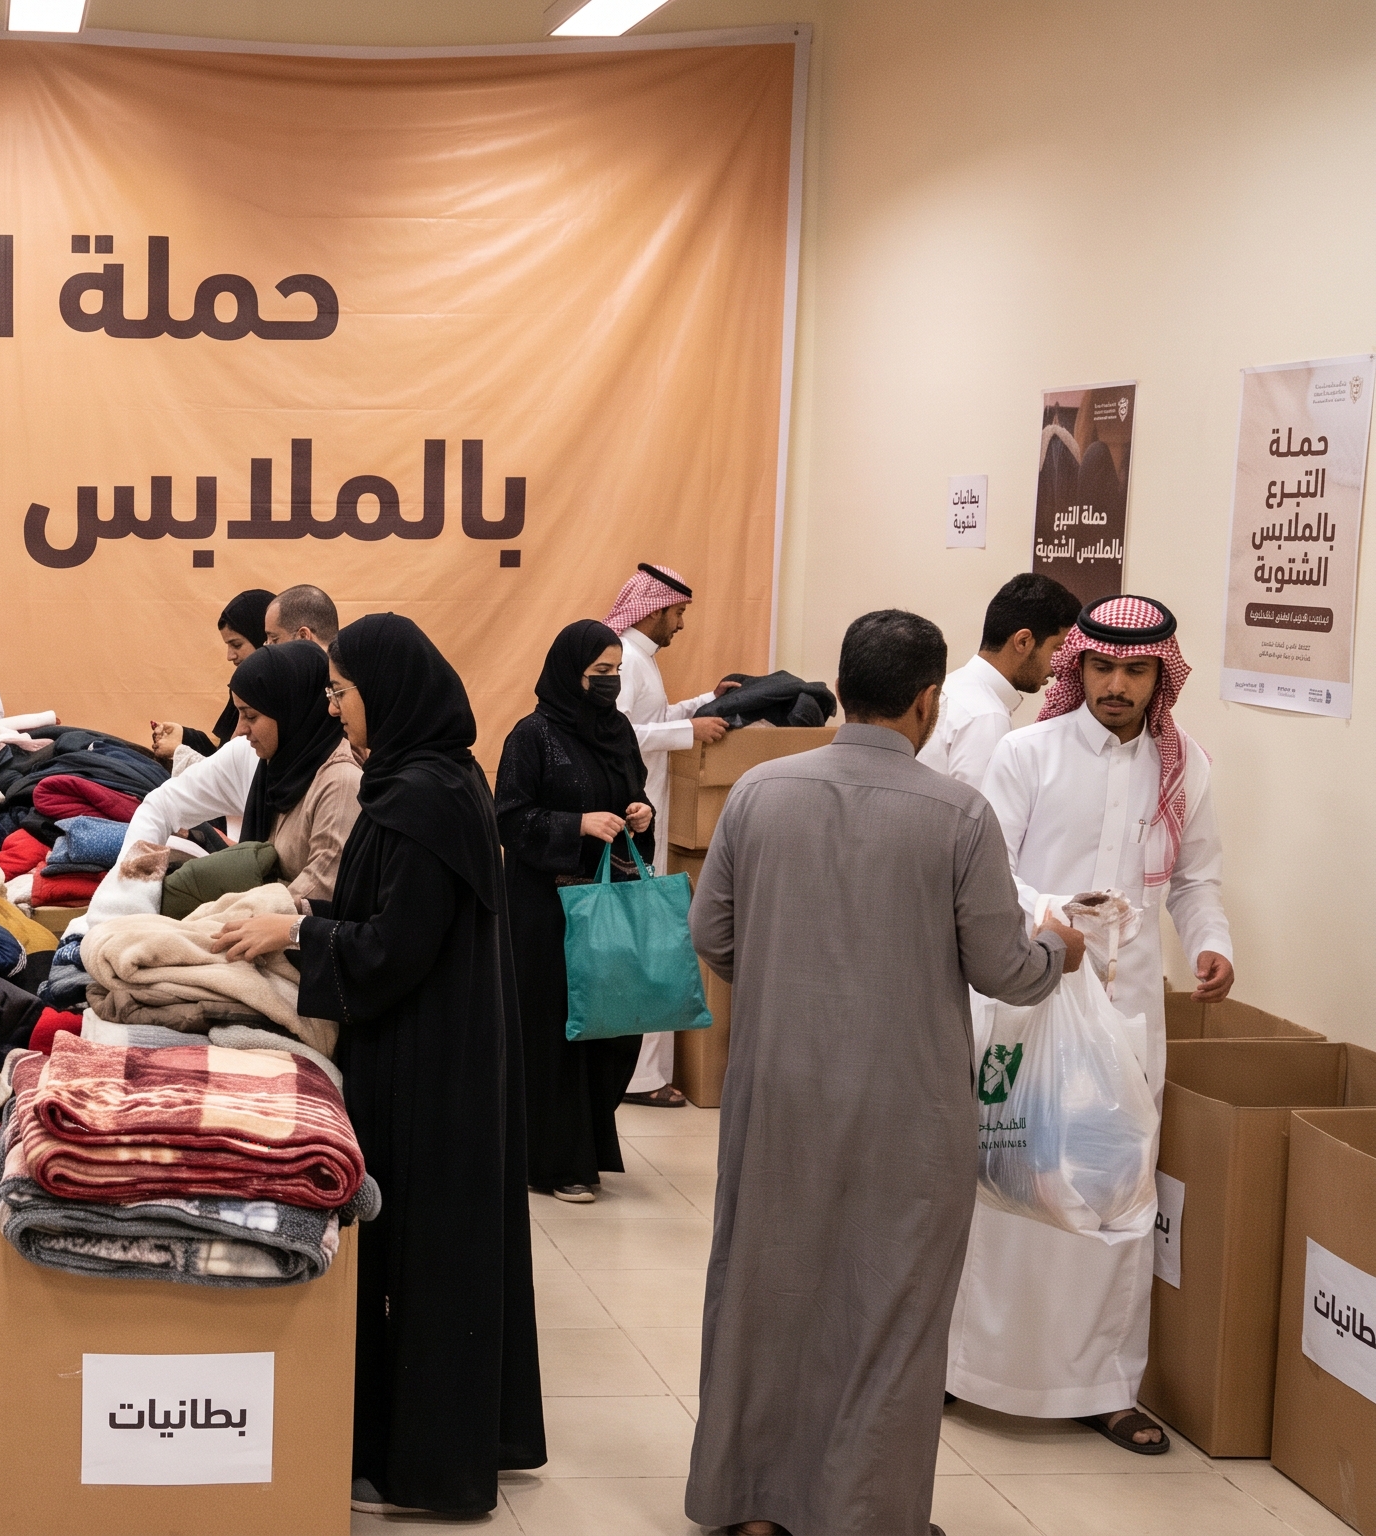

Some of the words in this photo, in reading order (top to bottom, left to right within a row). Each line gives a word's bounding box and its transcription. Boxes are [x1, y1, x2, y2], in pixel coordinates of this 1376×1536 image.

[59, 235, 339, 341] حملة
[1268, 426, 1329, 458] حملة
[24, 439, 526, 568] بالملابس
[1265, 467, 1326, 510] التبرع
[1080, 505, 1108, 525] حملة
[1251, 511, 1336, 552] بالملابس
[1035, 535, 1076, 563] الشتوية
[1075, 538, 1124, 565] بالملابس
[1254, 551, 1329, 594] الشتوية
[1313, 1289, 1376, 1350] طانيات
[108, 1398, 247, 1438] بطانيات
